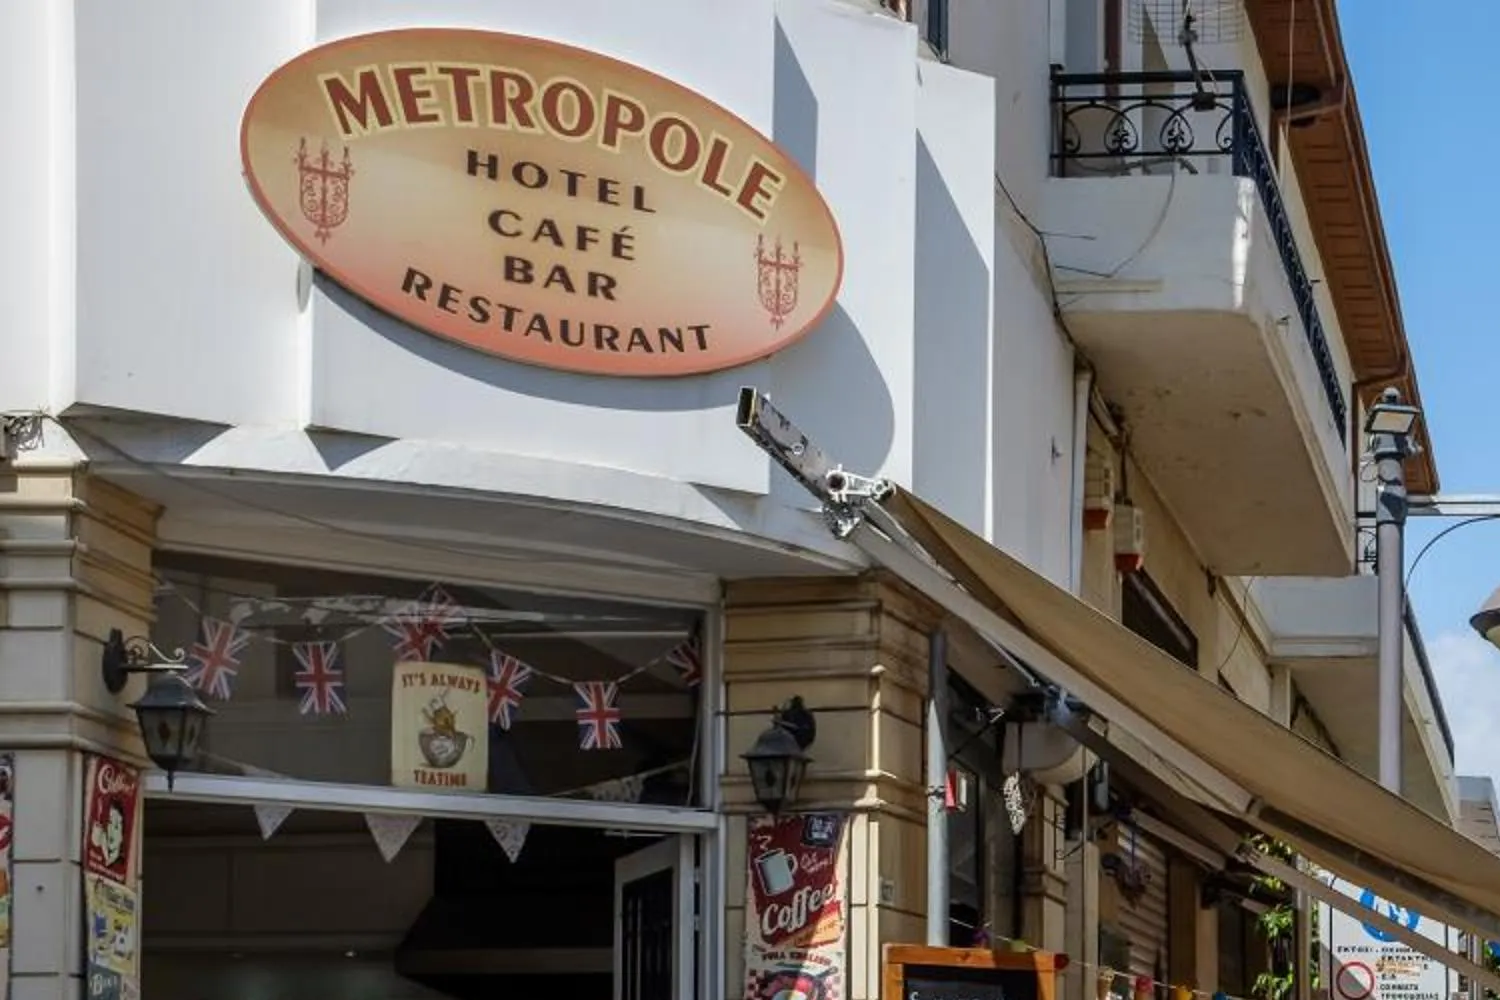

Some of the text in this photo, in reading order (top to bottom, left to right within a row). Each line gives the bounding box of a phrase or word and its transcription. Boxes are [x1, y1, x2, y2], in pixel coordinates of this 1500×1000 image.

[322, 63, 784, 222] METROPOLE
[467, 149, 656, 213] HOTEL
[488, 209, 637, 260] CAFÉ
[504, 257, 618, 301] BAR
[401, 267, 712, 353] RESTAURANT
[402, 672, 481, 694] IT'S ALWAYS
[413, 768, 467, 786] TEATIME
[761, 883, 835, 937] Coffee
[762, 951, 833, 966] FULL ENGLISH
